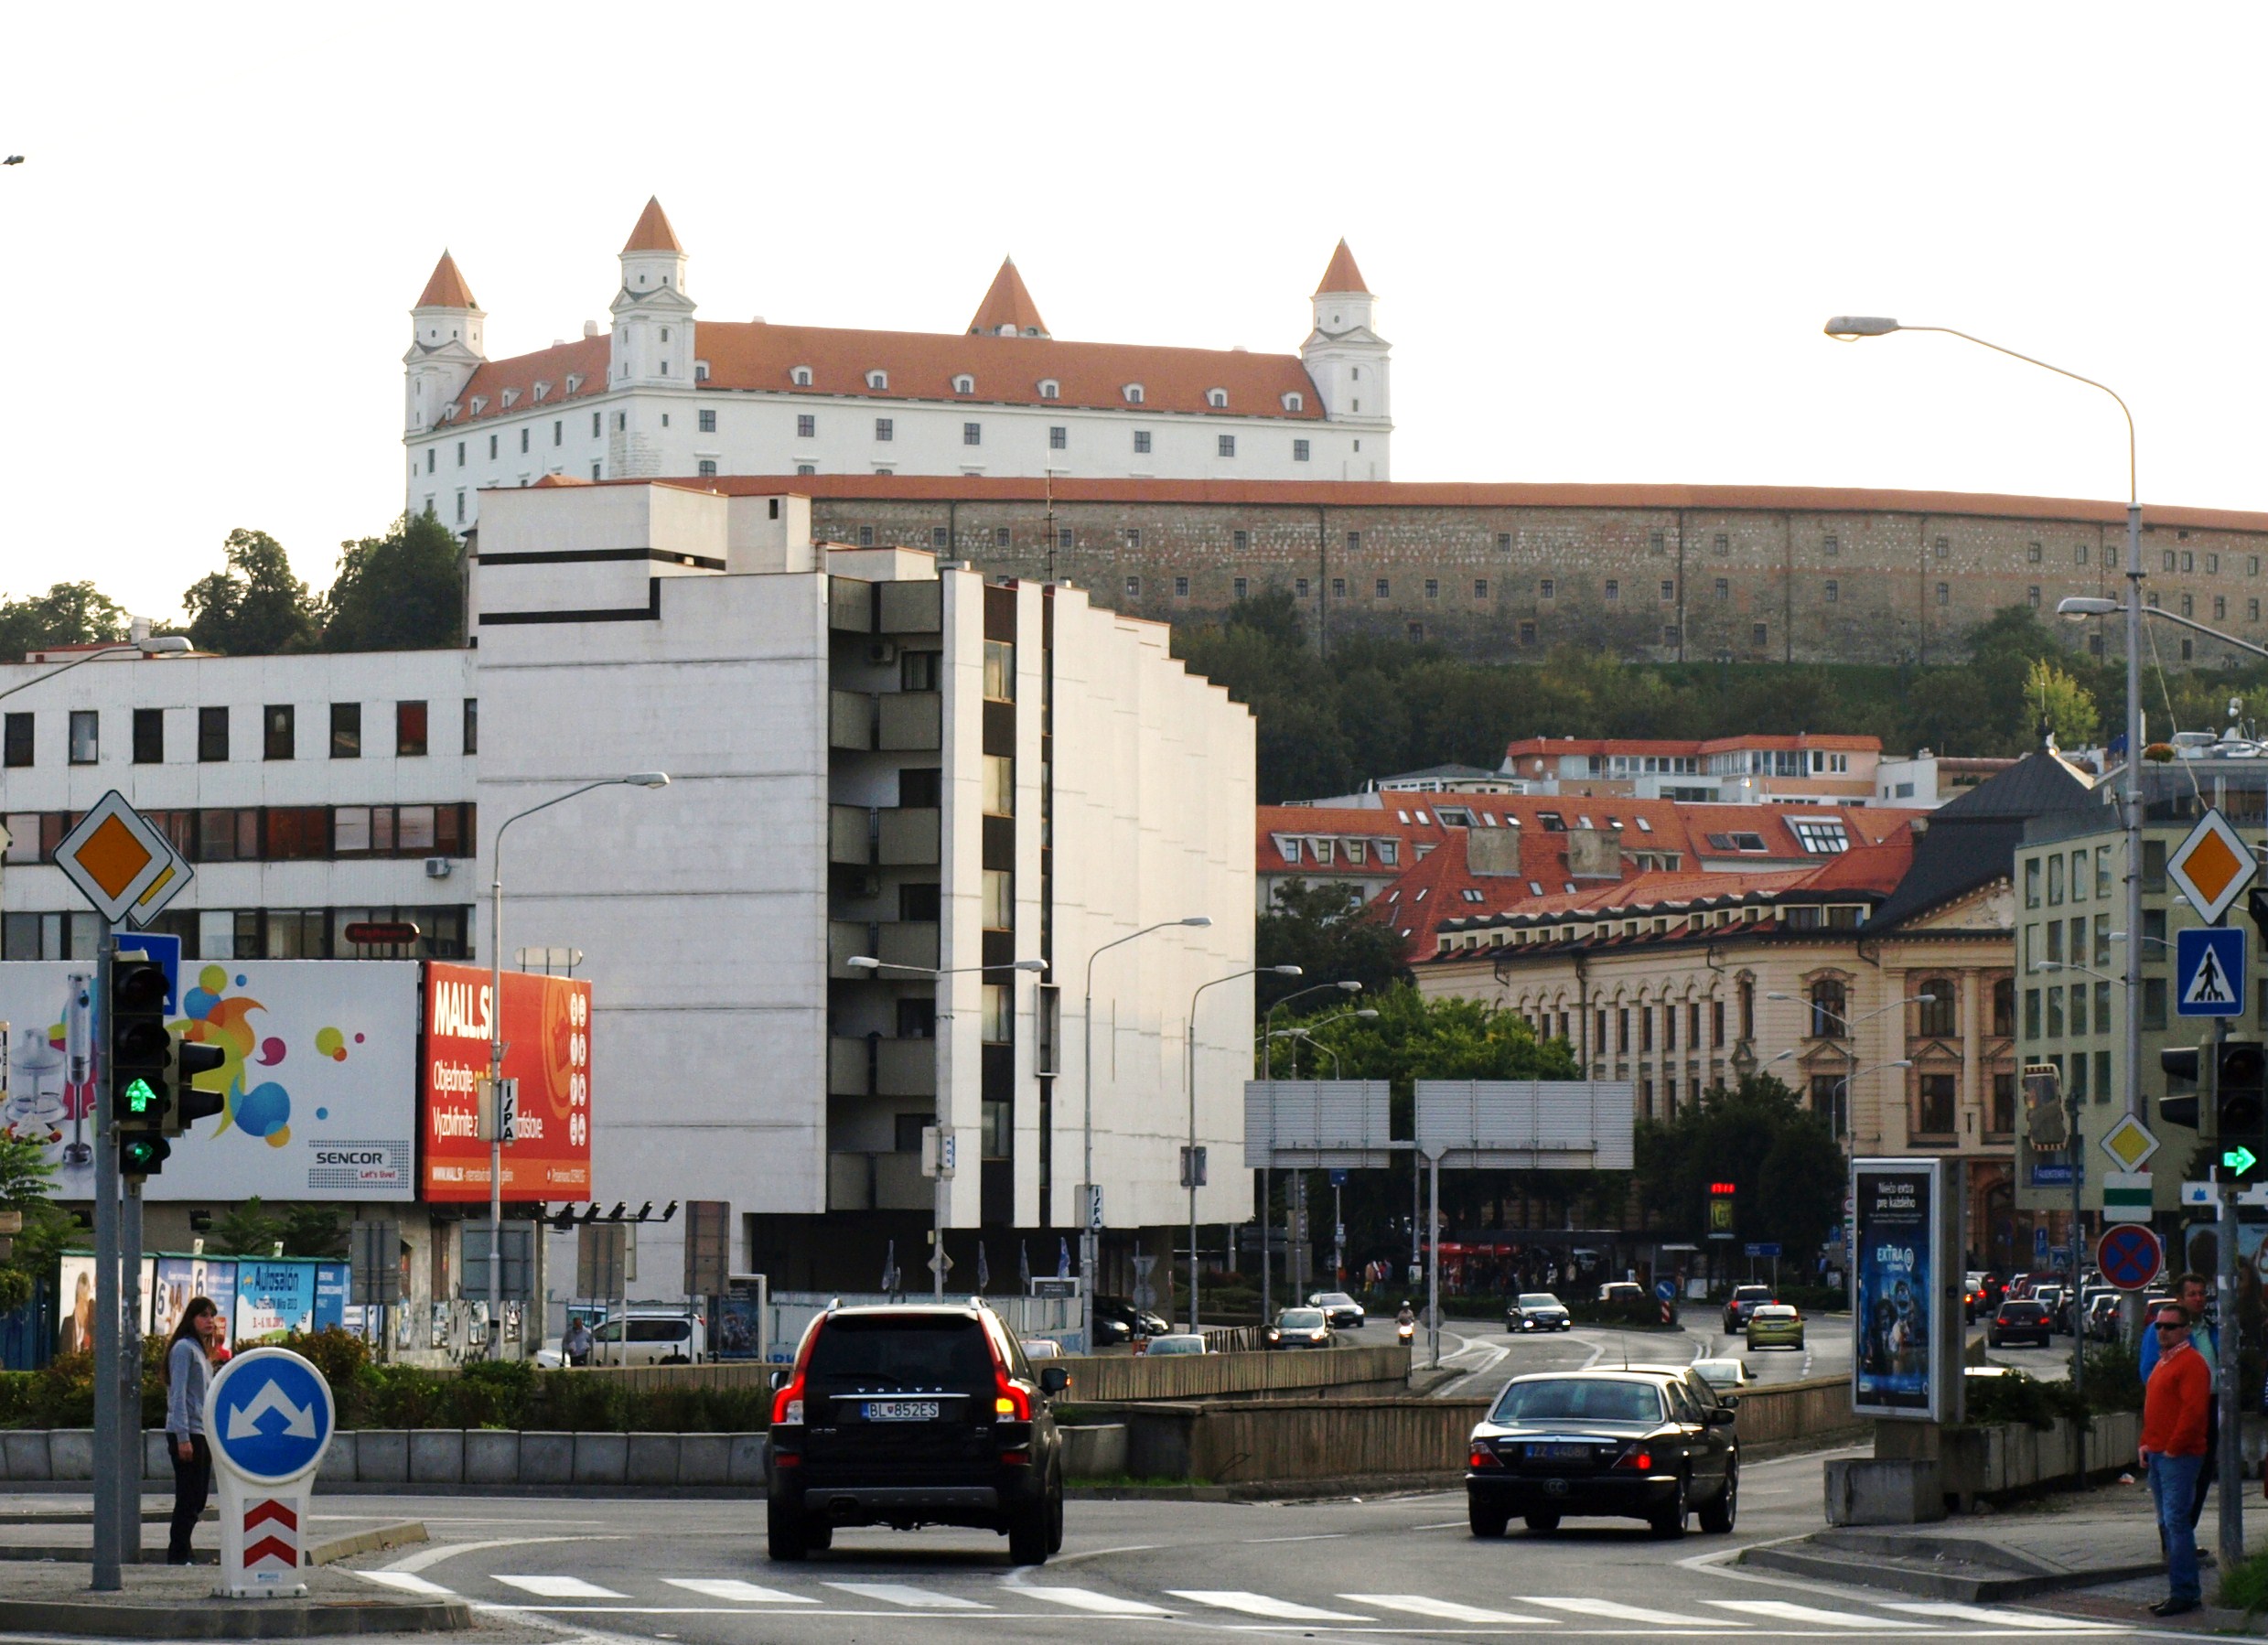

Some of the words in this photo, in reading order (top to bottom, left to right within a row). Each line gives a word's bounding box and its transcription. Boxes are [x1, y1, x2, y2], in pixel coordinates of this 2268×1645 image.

[434, 1059, 473, 1099] Objednajte
[503, 1085, 514, 1138] ISPA
[316, 1152, 382, 1165] SENCOR
[360, 1170, 378, 1178] Let's
[1897, 1183, 1915, 1194] extra
[1876, 1199, 1887, 1210] pre
[1876, 1245, 1904, 1262] EXTRA
[254, 1265, 299, 1292] Autosalón
[157, 1283, 166, 1315] 6
